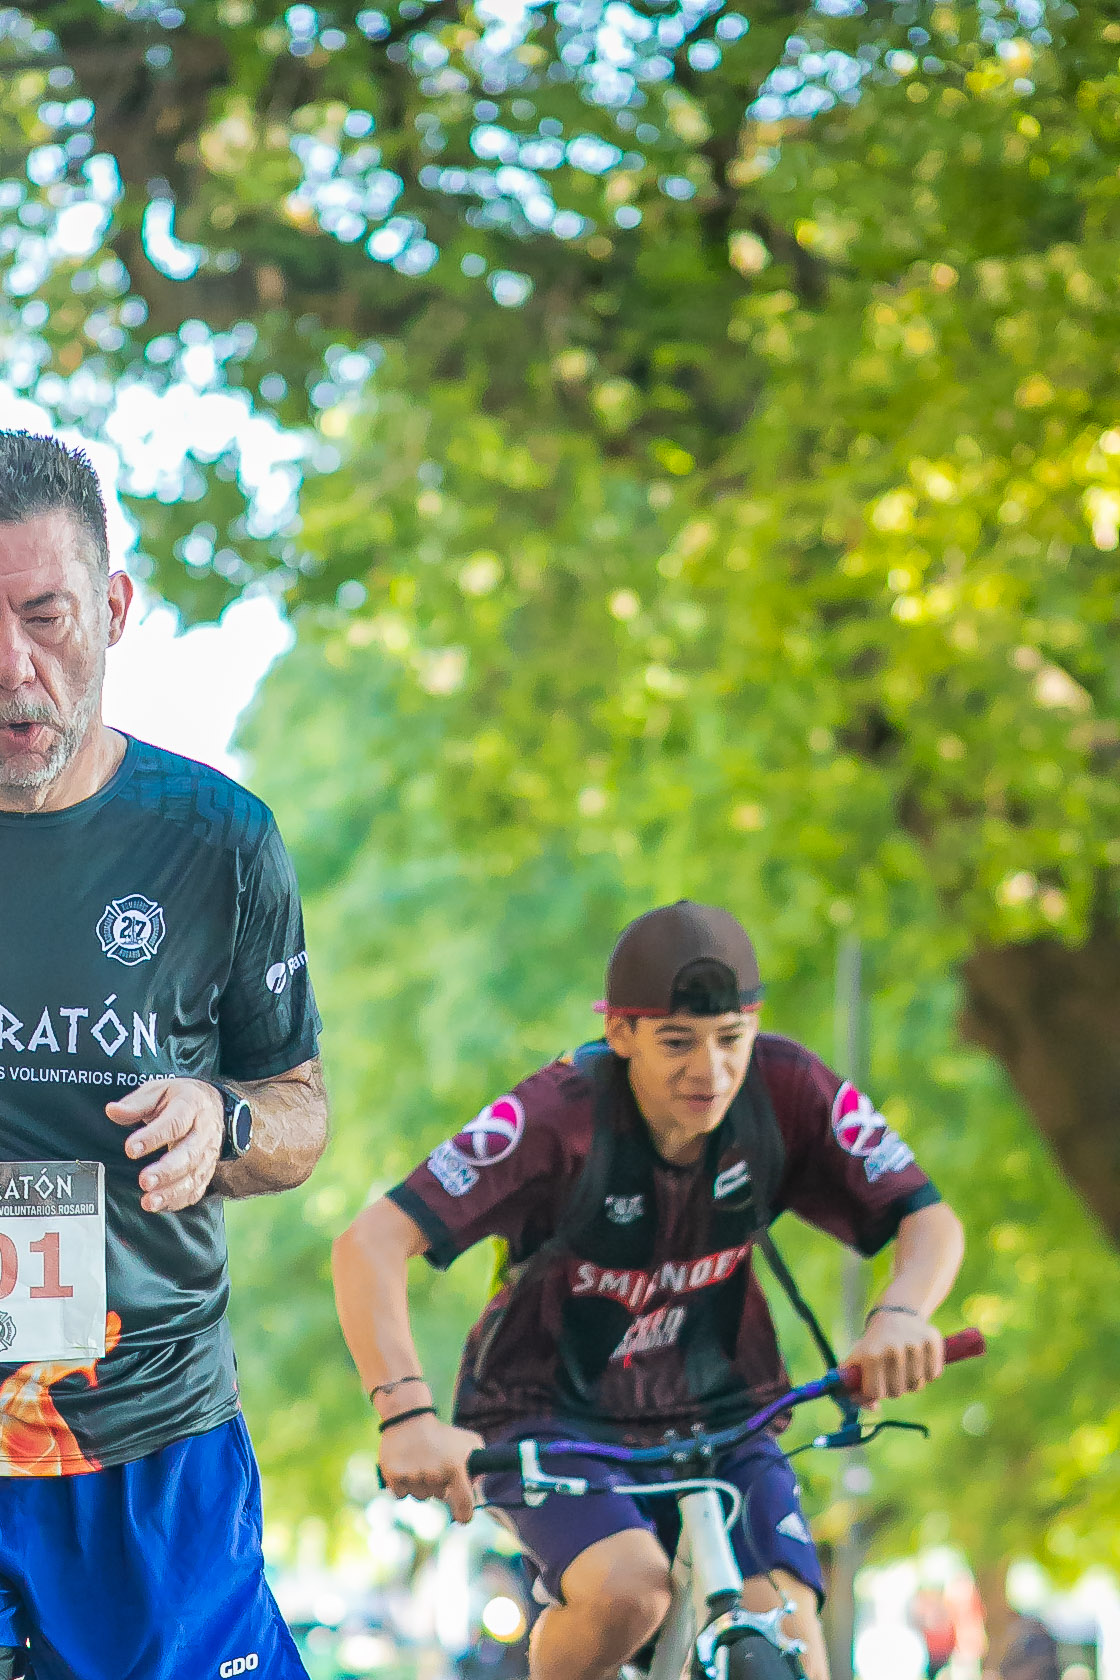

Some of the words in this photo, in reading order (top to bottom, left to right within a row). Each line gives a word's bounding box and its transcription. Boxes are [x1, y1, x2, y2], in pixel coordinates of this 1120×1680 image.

[119, 915, 147, 939] 27
[9, 1066, 112, 1086] VOLUNTARIOS
[58, 1203, 95, 1215] ROSARIO
[219, 1653, 259, 1679] GDO
